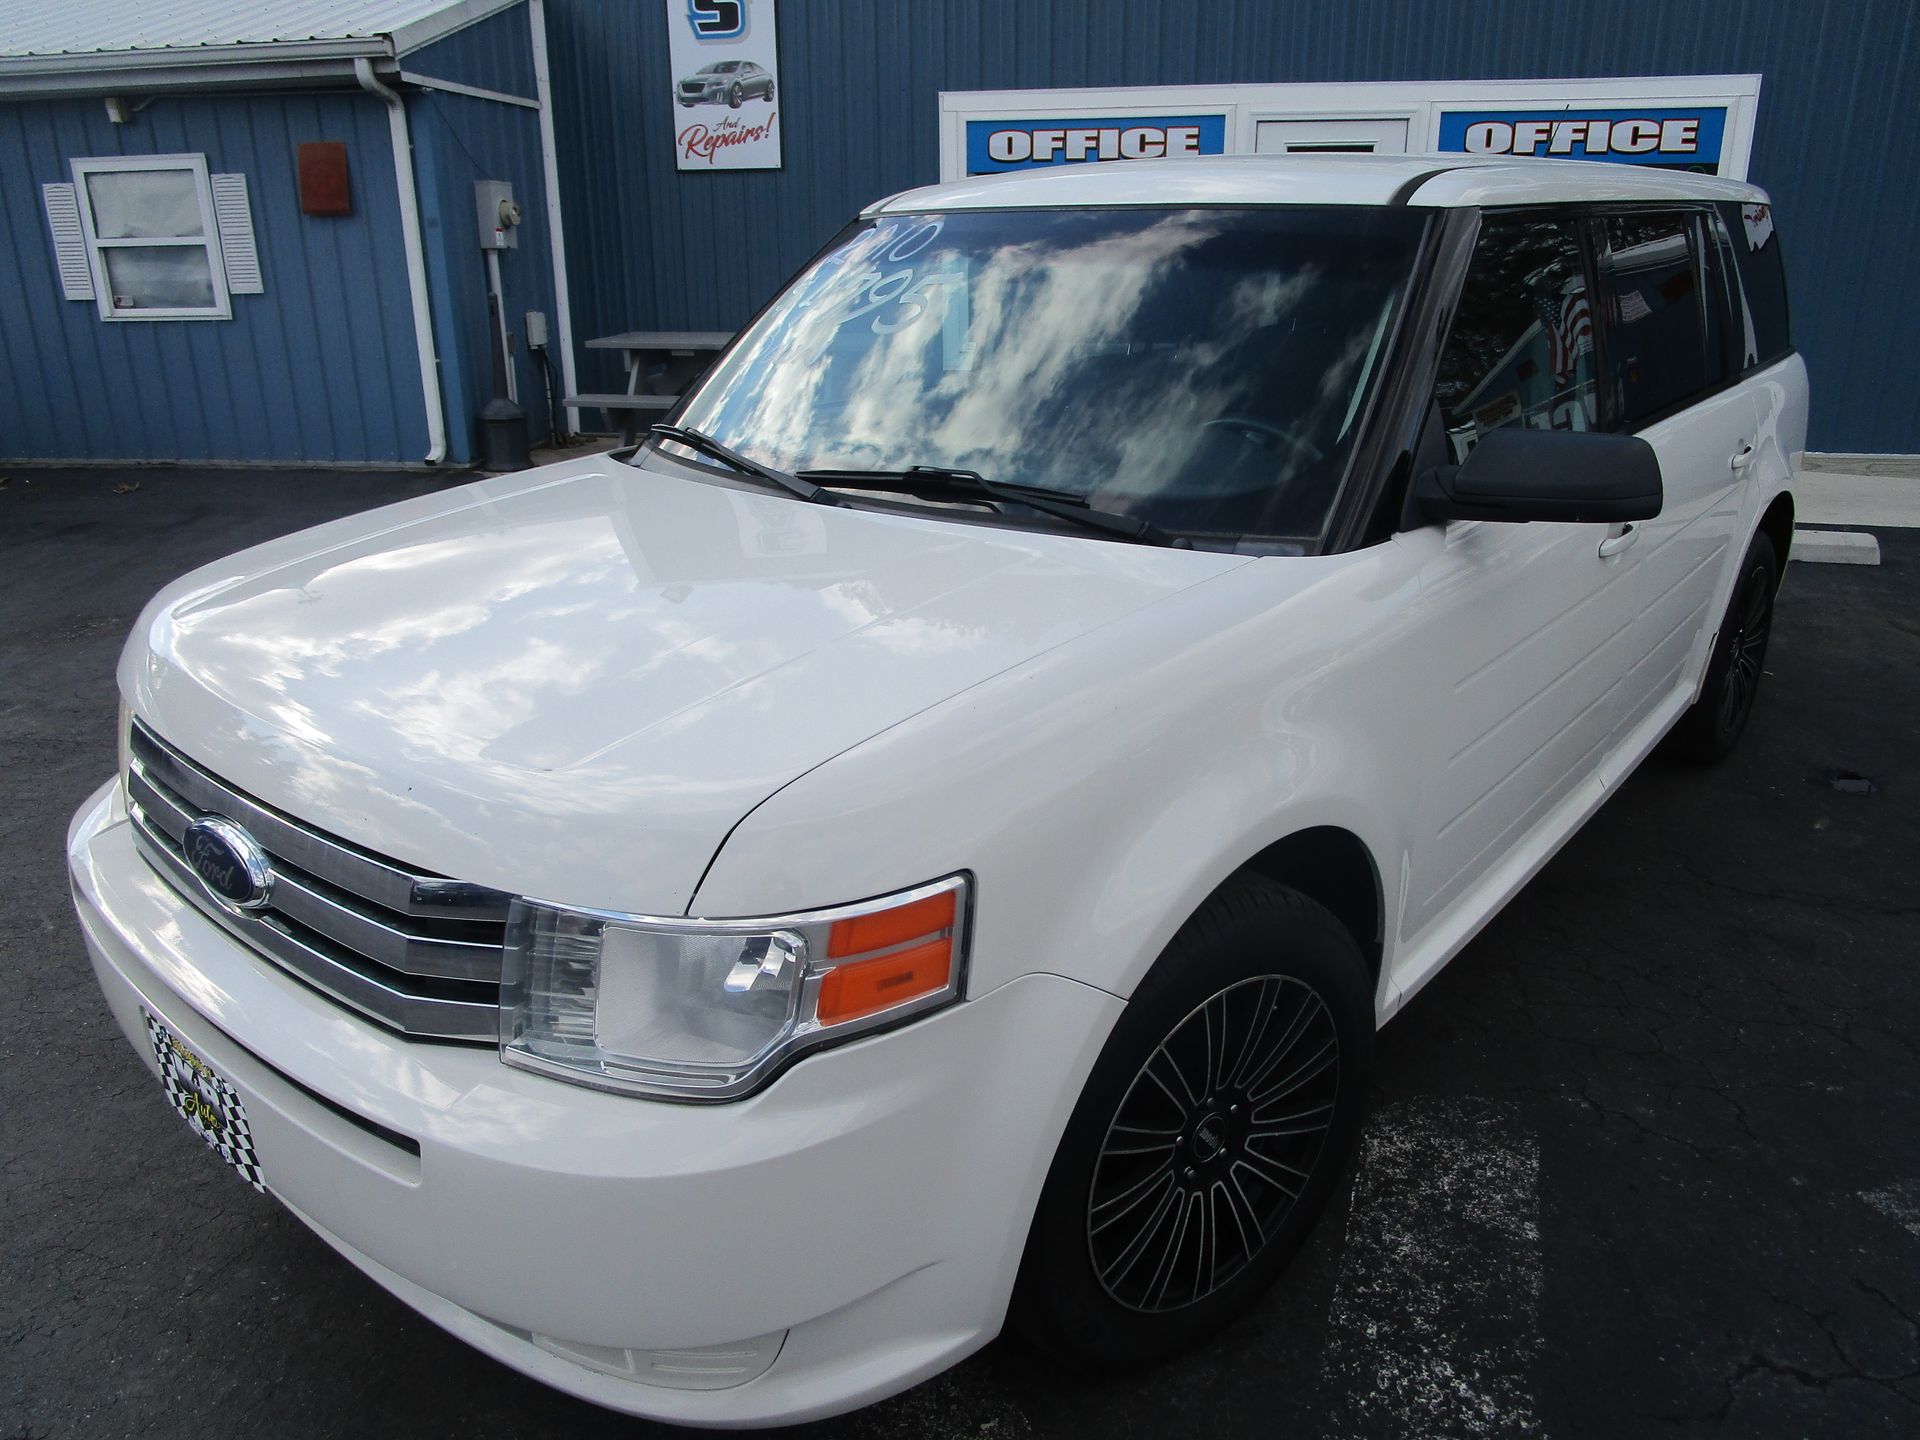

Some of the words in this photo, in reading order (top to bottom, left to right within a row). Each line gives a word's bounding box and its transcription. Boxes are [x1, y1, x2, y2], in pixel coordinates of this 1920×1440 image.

[678, 112, 776, 164] Repairs!
[713, 116, 741, 132] And
[1464, 118, 1699, 155] OFFICE
[988, 125, 1200, 162] OFFICE
[191, 835, 235, 890] Ford
